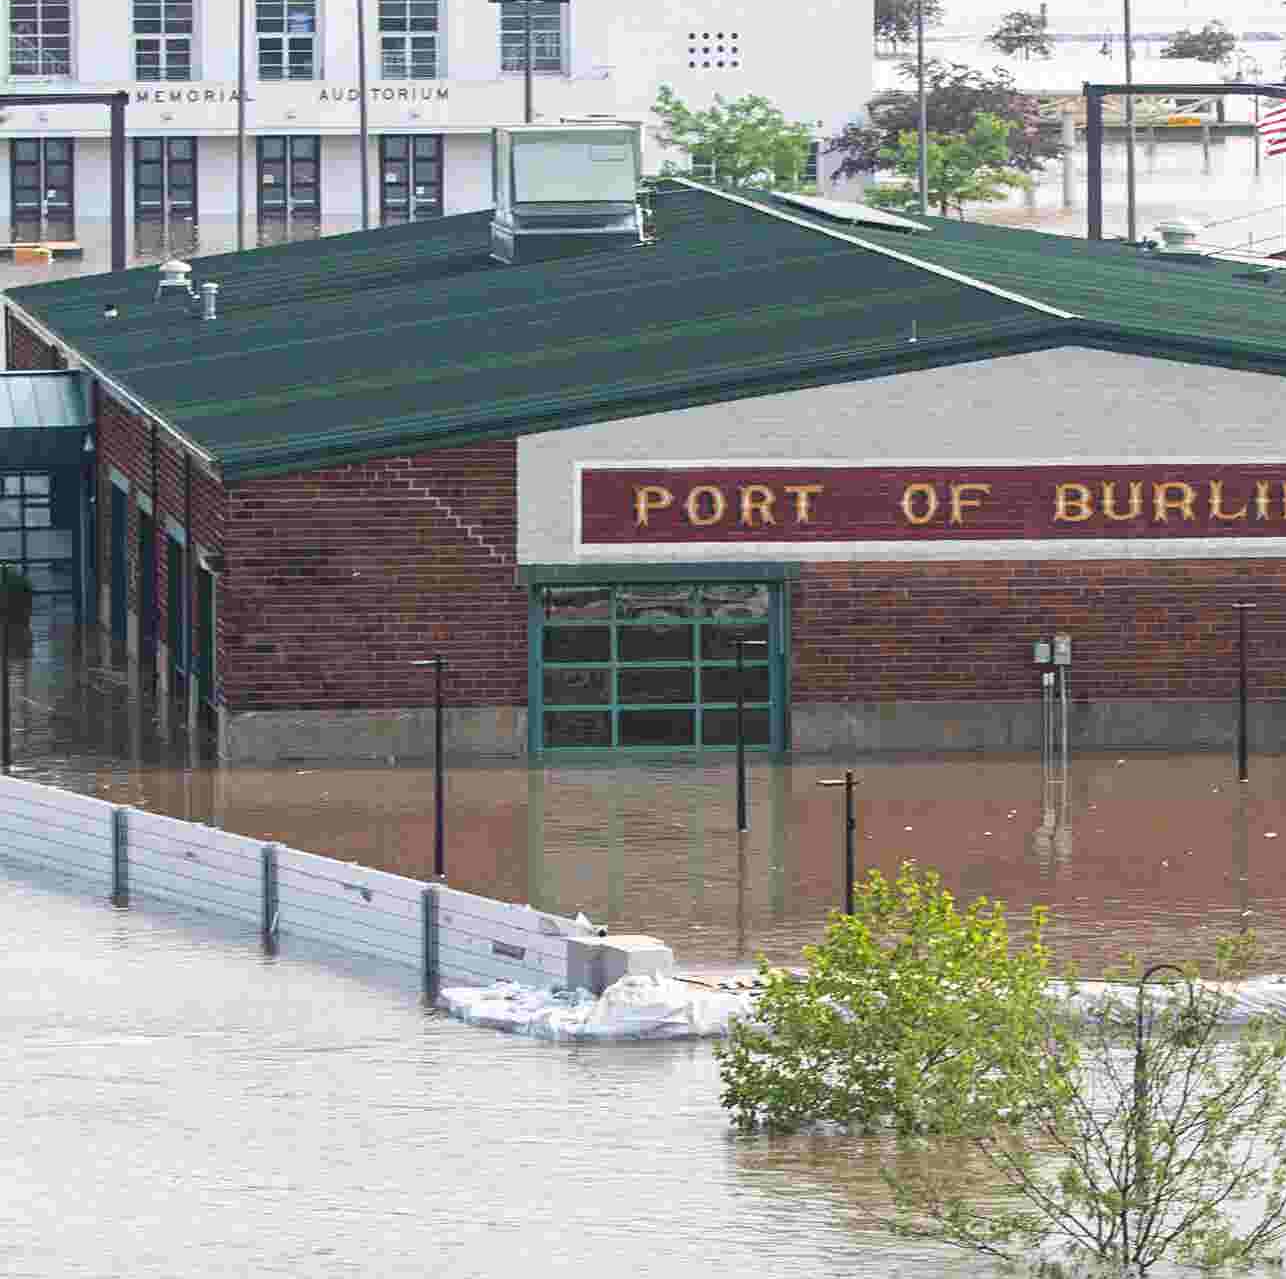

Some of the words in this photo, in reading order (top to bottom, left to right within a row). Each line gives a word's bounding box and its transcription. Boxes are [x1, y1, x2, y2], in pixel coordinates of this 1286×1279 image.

[319, 87, 449, 102] AUDTORIUM
[633, 483, 824, 527] PORT
[902, 482, 992, 527] OF
